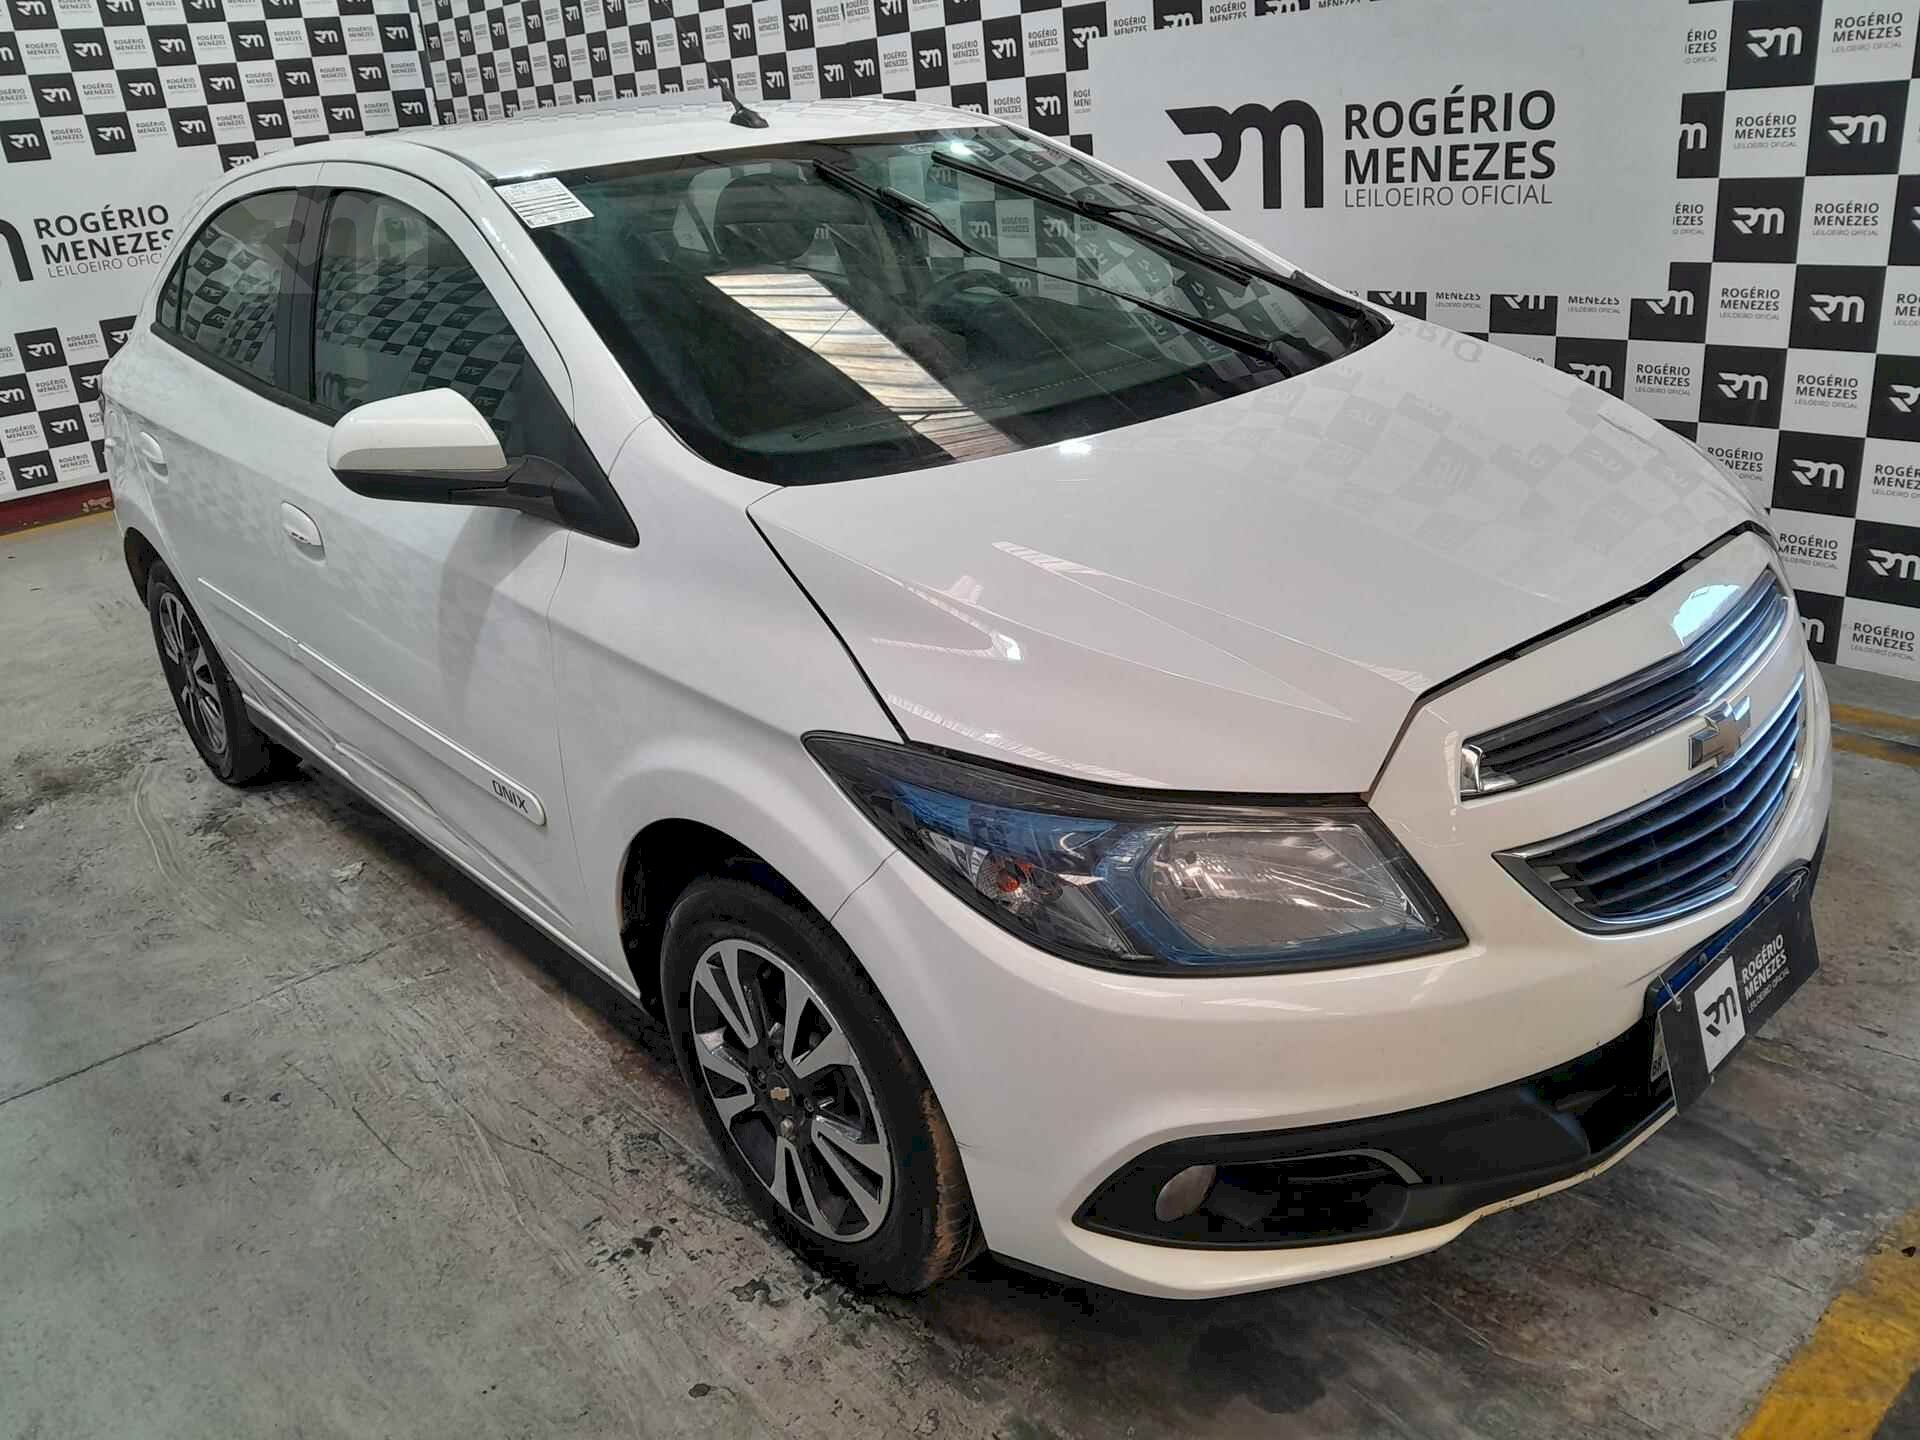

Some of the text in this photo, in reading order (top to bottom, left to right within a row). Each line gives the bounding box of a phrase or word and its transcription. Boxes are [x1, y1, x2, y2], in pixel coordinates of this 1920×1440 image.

[1114, 16, 1146, 27] ROGÉRIO
[1834, 12, 1903, 29] ROGÉRIO
[1028, 29, 1057, 39] ROGÉRIO
[1687, 27, 1717, 42] ÉRIO
[1833, 26, 1902, 42] MENEZES
[1029, 38, 1058, 48] MENEZES
[1685, 42, 1717, 54] EZES
[1747, 26, 1802, 58] RM
[1345, 84, 1555, 140] ROGÉRIO
[1736, 112, 1797, 127] ROGÉRIO
[1735, 126, 1796, 139] MENEZES
[1828, 114, 1887, 144] RM
[1165, 100, 1324, 211] RM
[1345, 140, 1556, 184] MENEZES
[1345, 183, 1552, 208] LEILOEIRO OFICIAL
[1675, 201, 1703, 214] ÉRIO
[1815, 200, 1879, 213] ROGÉRIO
[34, 204, 168, 239] ROGÉRIO
[1673, 216, 1703, 226] EZES
[1732, 208, 1784, 233] RM
[1814, 215, 1878, 226] MENEZES
[48, 253, 161, 277] LEILOEIRO OFIC
[1721, 286, 1779, 298] ROGÉRIO
[1720, 300, 1779, 311] MENEZES
[1810, 295, 1864, 322] RM
[1636, 363, 1690, 375] ROGÉRIO
[1636, 375, 1690, 387] MENEZES
[1717, 372, 1768, 400] RM
[1796, 374, 1858, 388] ROGÉRIO
[1796, 386, 1857, 399] MENEZES
[1792, 459, 1844, 488] RM
[1875, 464, 1920, 478] ROGÉR
[1874, 476, 1920, 490] MENEZ
[1779, 533, 1838, 549] ROGÉRIO
[1778, 546, 1837, 560] MENEZES
[1853, 622, 1915, 640] ROGÉRIO
[1852, 633, 1914, 651] MENEZES
[492, 780, 528, 813] ONIX
[1741, 934, 1784, 984] ROGÉRIO
[1744, 949, 1787, 1000] MENEZES
